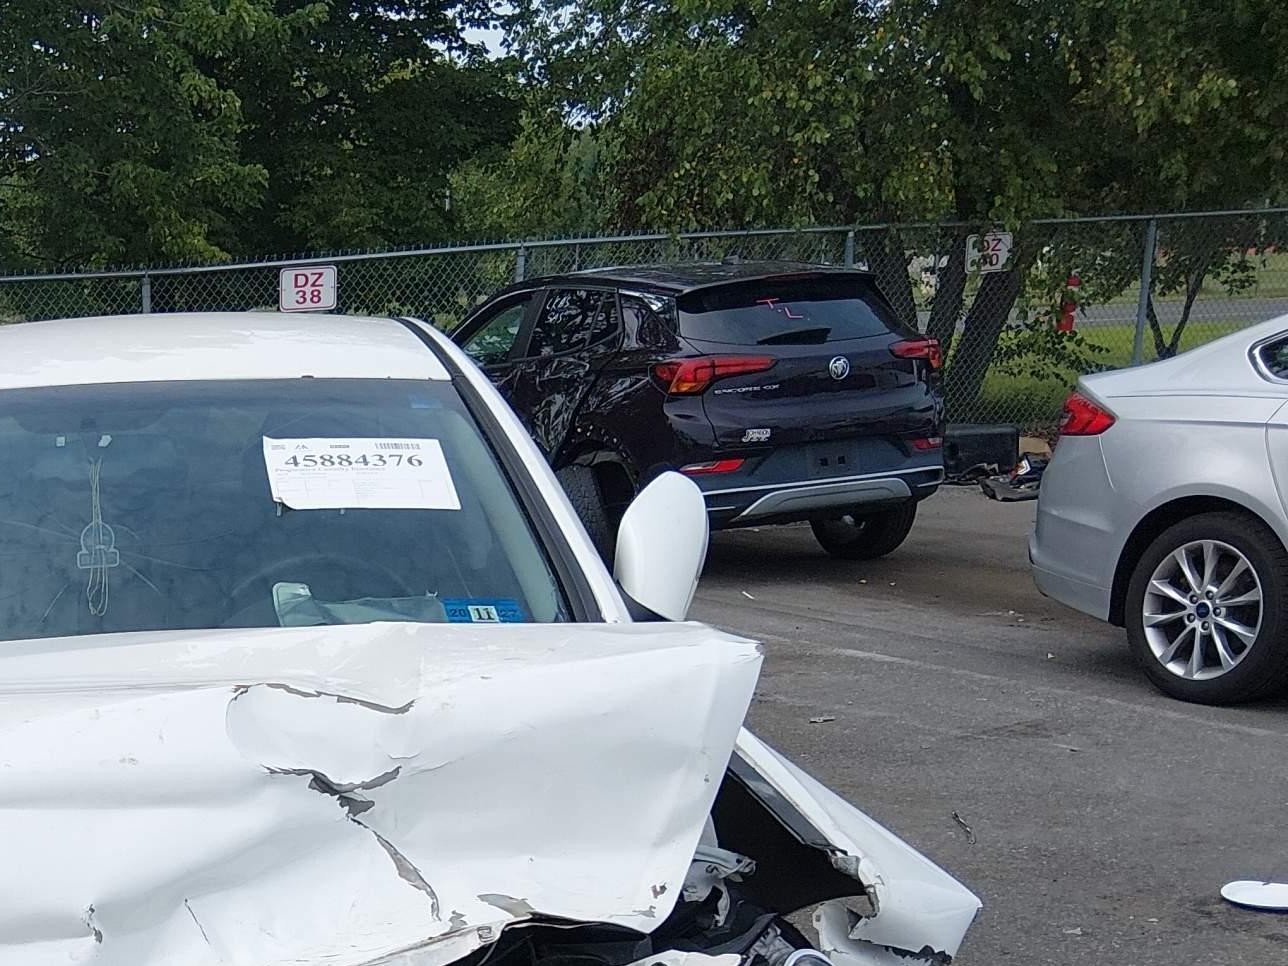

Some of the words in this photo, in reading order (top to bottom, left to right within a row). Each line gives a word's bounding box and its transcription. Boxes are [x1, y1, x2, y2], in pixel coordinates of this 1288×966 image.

[294, 272, 324, 289] DZ
[295, 289, 322, 305] 38
[284, 454, 423, 468] 45884376
[473, 607, 495, 620] 11
